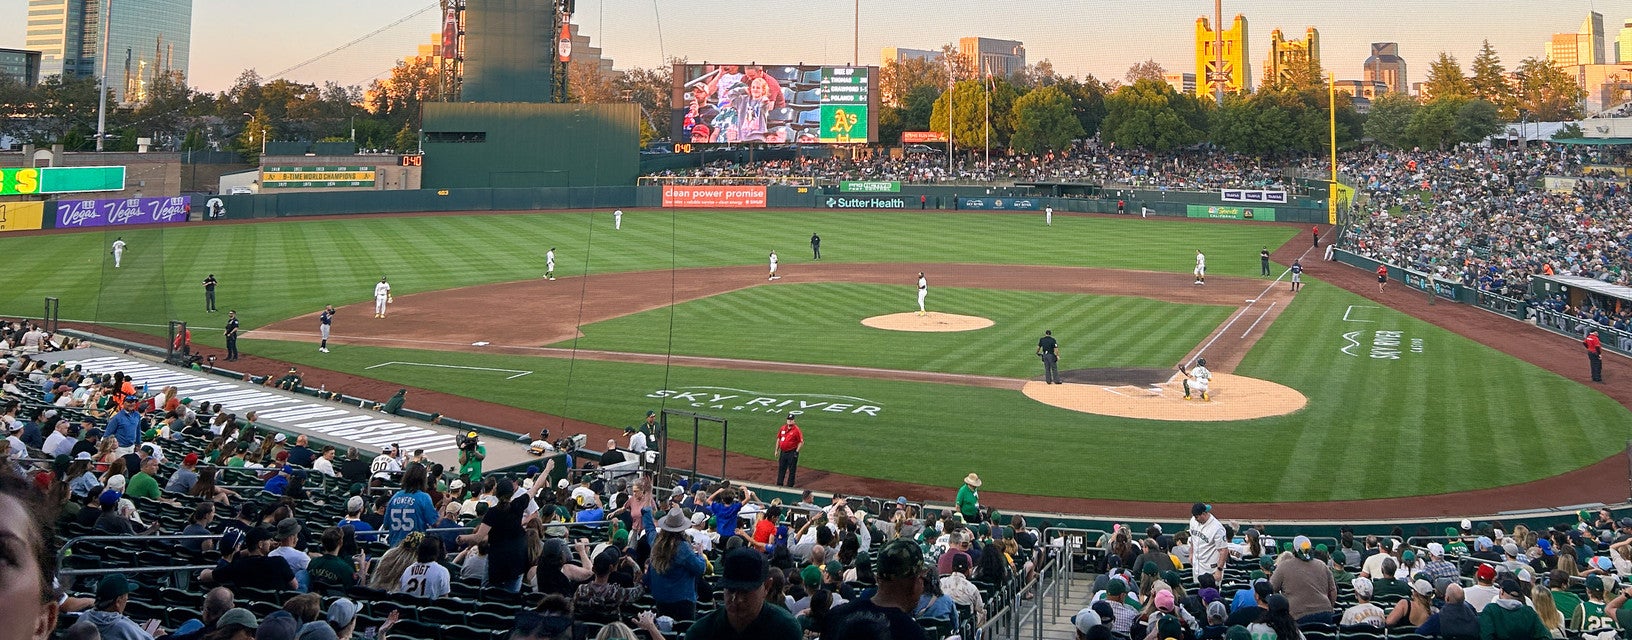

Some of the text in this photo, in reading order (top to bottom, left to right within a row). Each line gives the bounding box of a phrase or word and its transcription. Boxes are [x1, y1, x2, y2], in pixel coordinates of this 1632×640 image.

[675, 143, 691, 153] 0:40
[402, 156, 422, 166] 0:40
[666, 189, 764, 199] clean power promise
[838, 198, 904, 208] Sutter Health
[58, 204, 100, 226] Vegas
[104, 202, 144, 224] Vegas
[148, 199, 187, 221] Vegas
[646, 389, 882, 416] SKY RIVER
[691, 402, 804, 415] CASINO
[254, 403, 350, 422] FOR
[390, 508, 416, 532] 55
[410, 565, 430, 576] VOGT
[406, 578, 426, 596] 21
